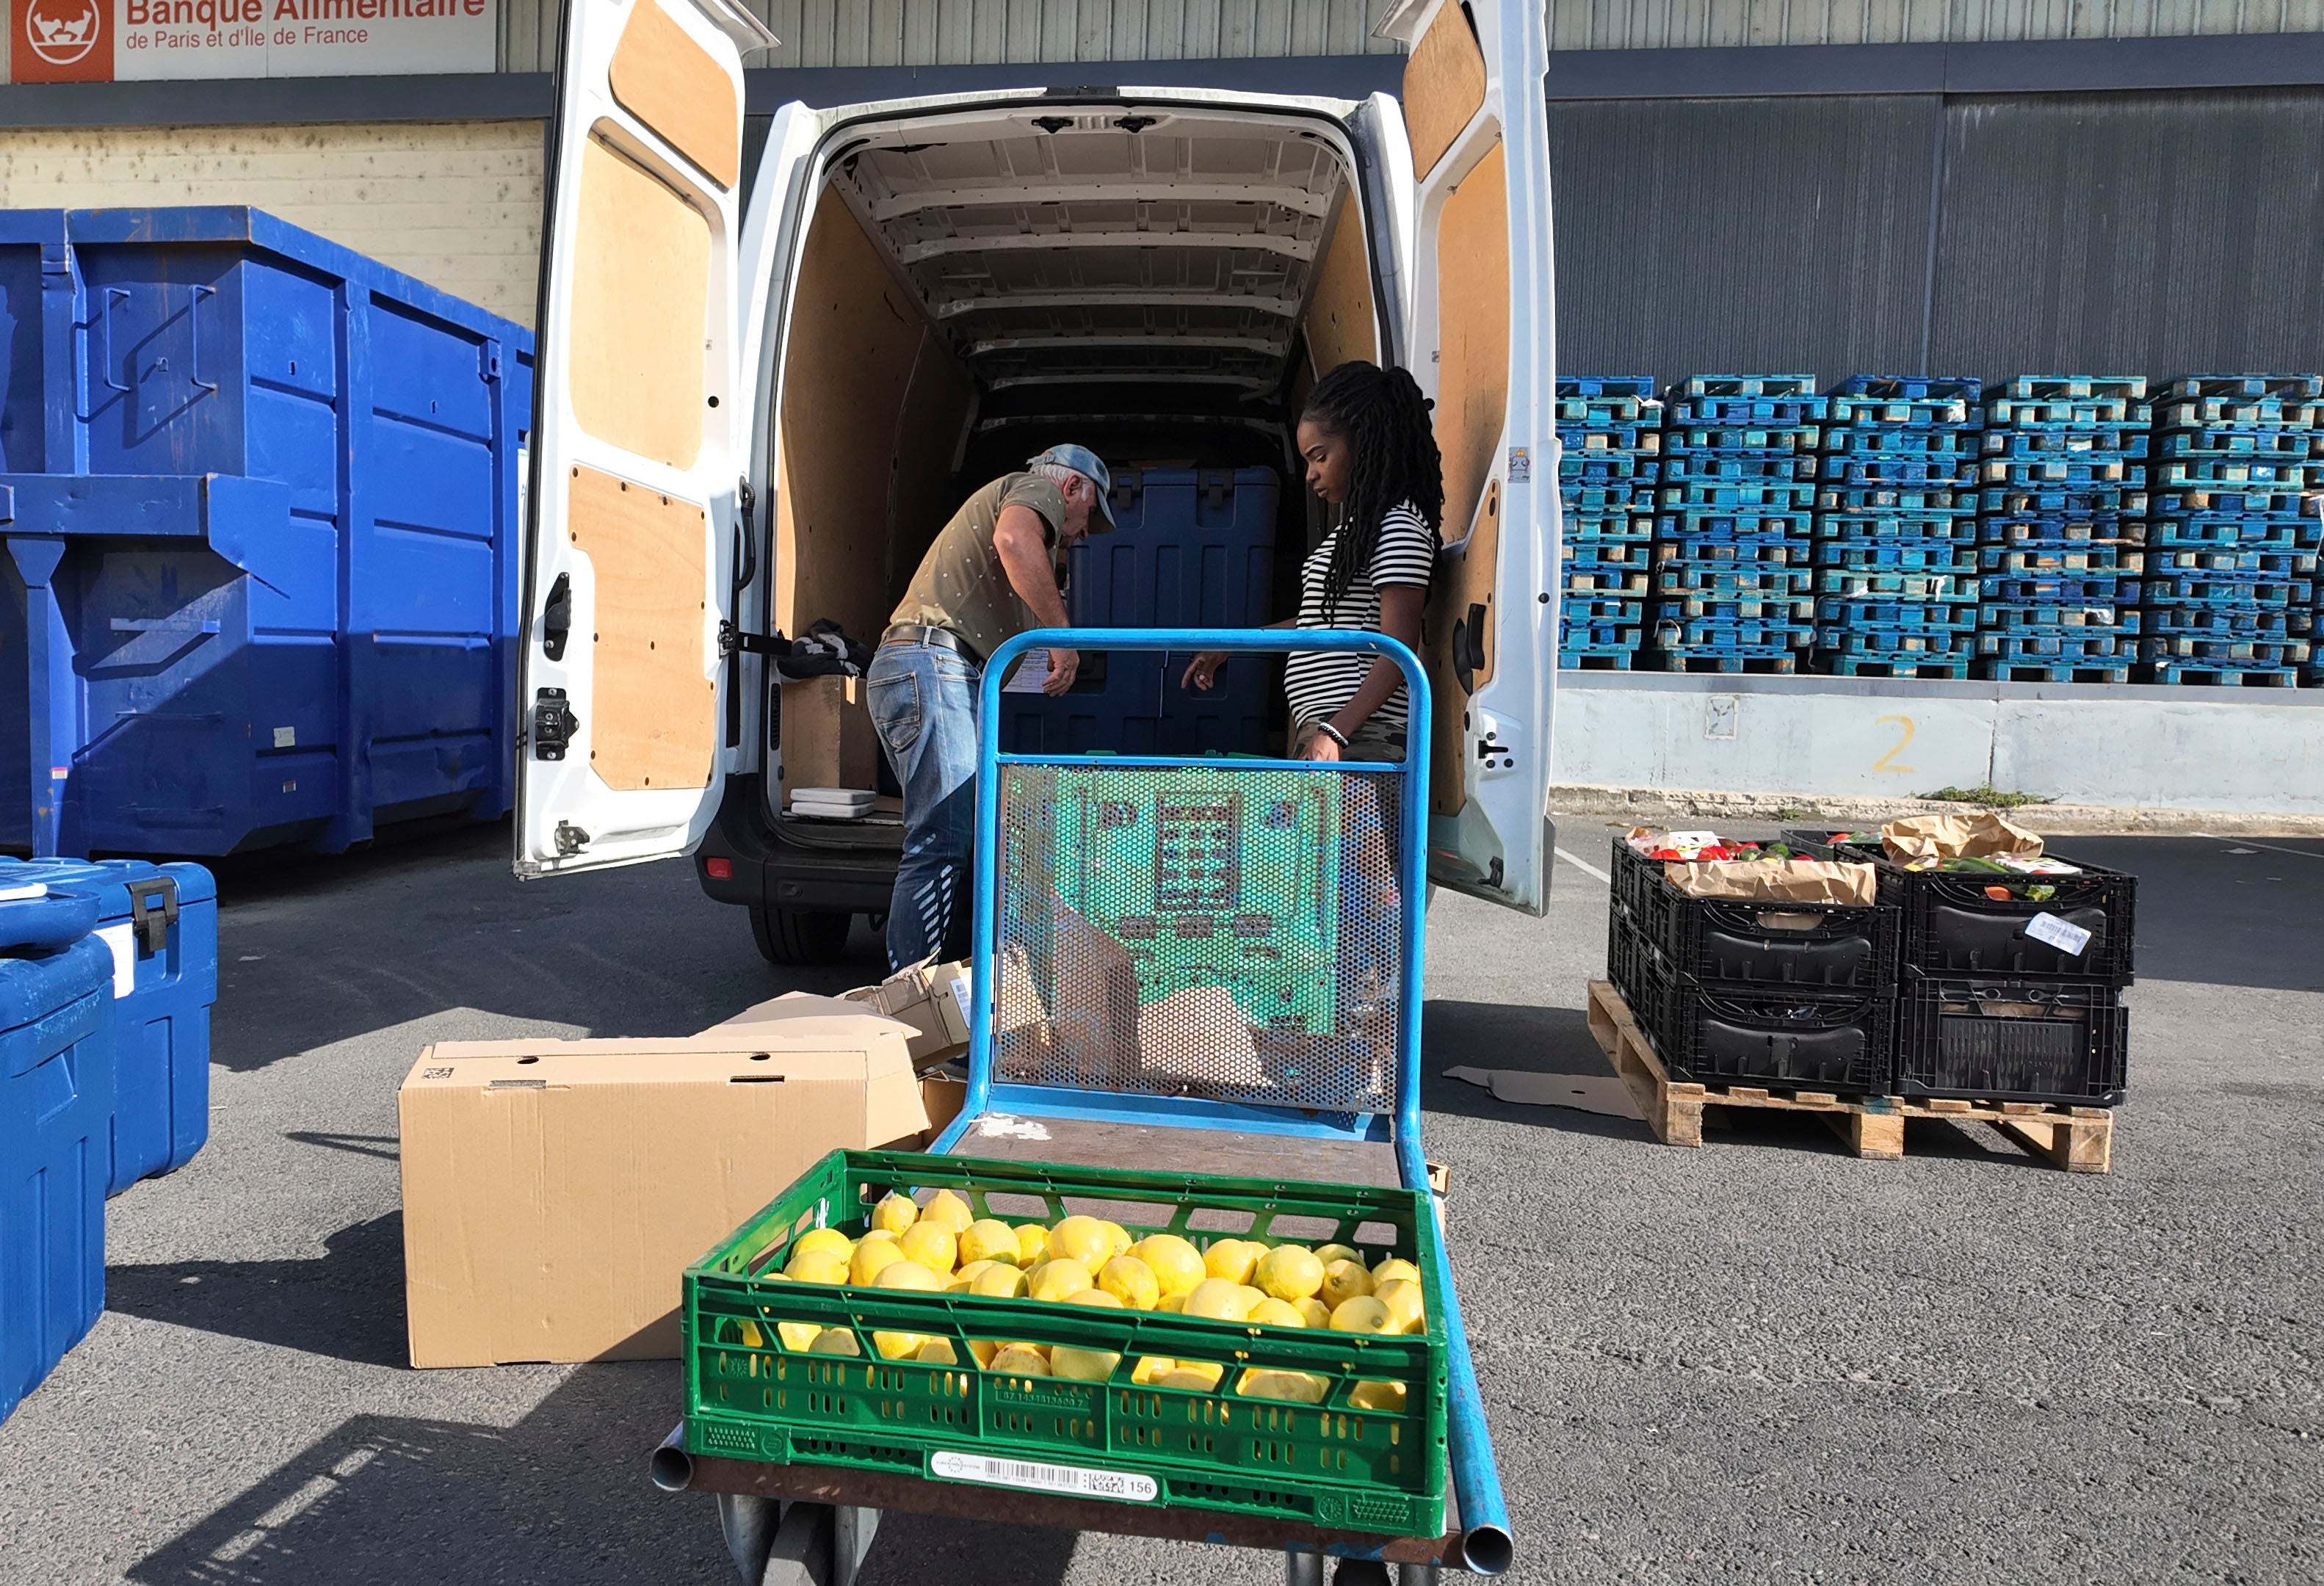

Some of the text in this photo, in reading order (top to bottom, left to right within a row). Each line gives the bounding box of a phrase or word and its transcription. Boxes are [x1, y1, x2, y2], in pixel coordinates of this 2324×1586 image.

[126, 0, 485, 32] Banque Alimentaire
[126, 26, 369, 50] de Paris et d'Île de France
[1872, 714, 1916, 772] 2
[1131, 1481, 1152, 1494] 156
